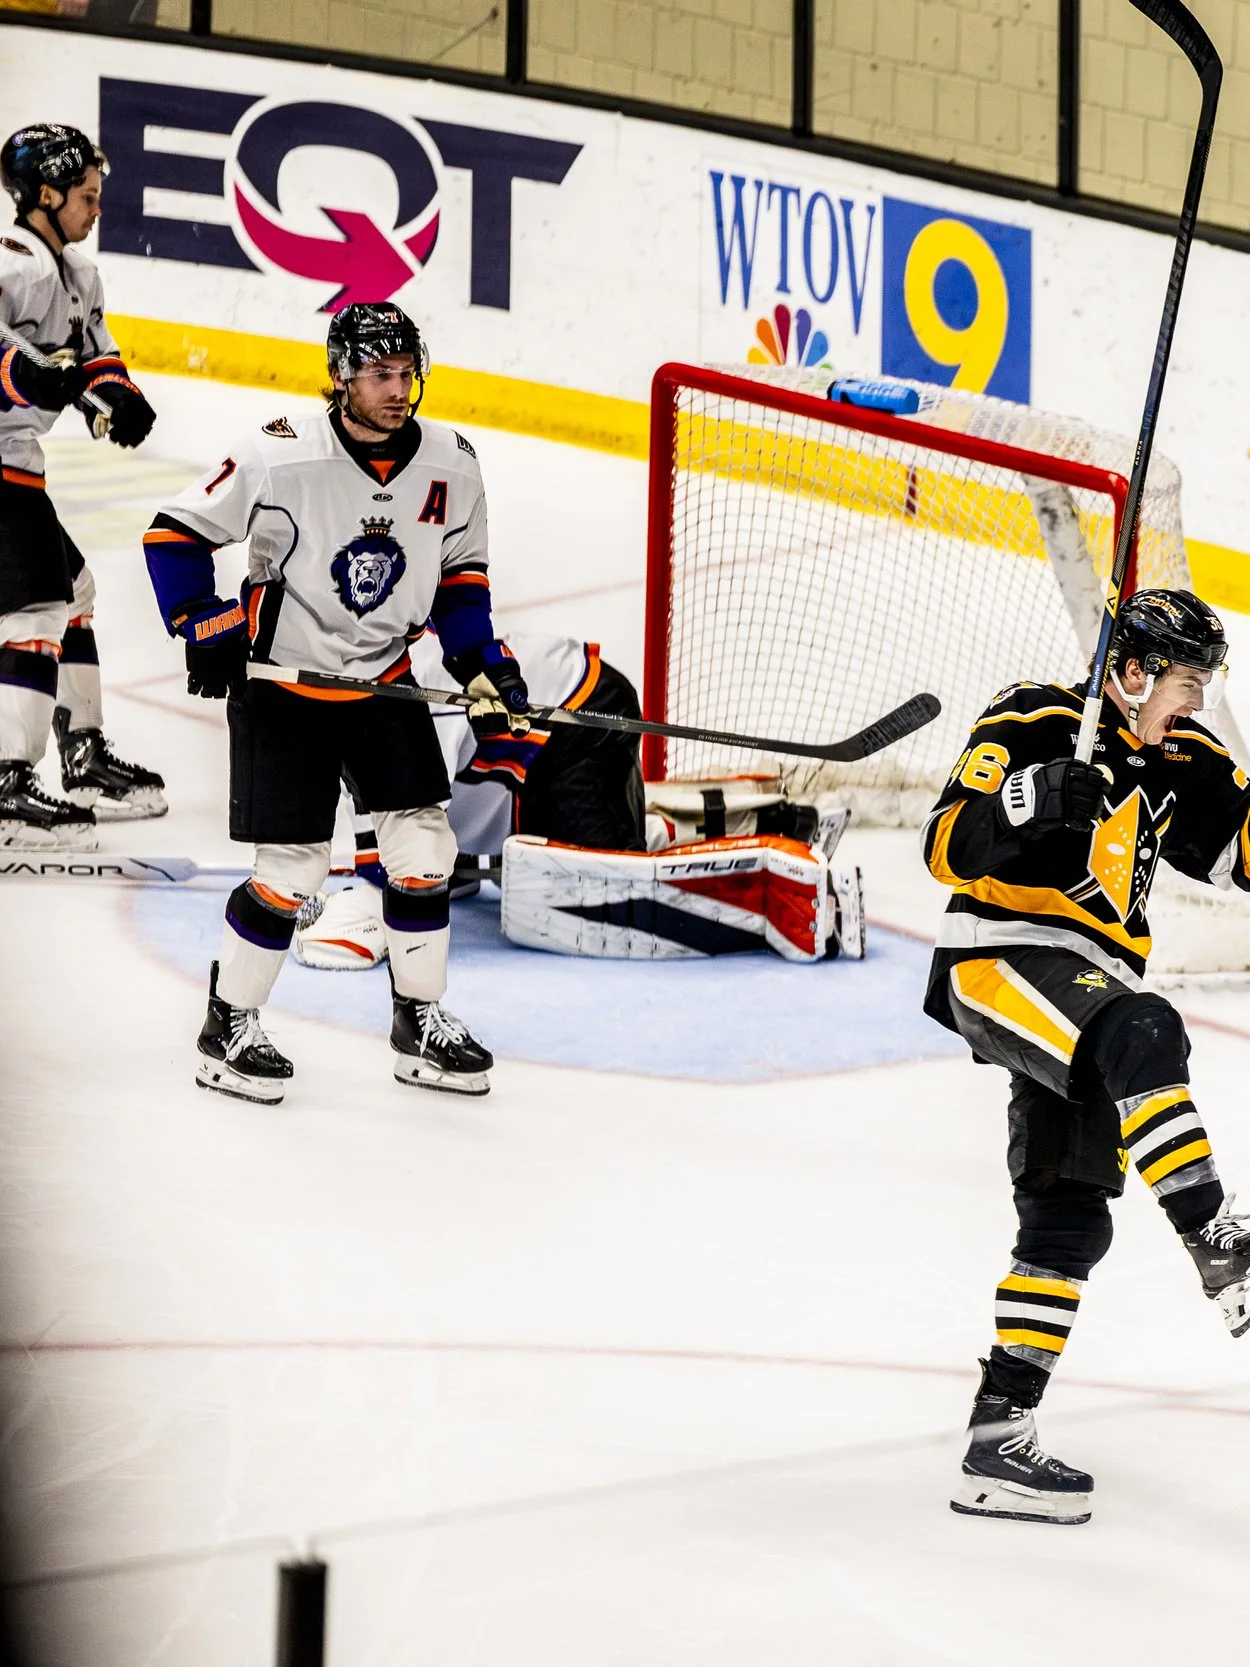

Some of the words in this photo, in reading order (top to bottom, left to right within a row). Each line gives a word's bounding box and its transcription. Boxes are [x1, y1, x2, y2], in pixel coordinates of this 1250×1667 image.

[98, 76, 585, 313] EQT
[709, 170, 876, 336] WTOV
[904, 218, 1009, 394] 9
[417, 480, 448, 526] A
